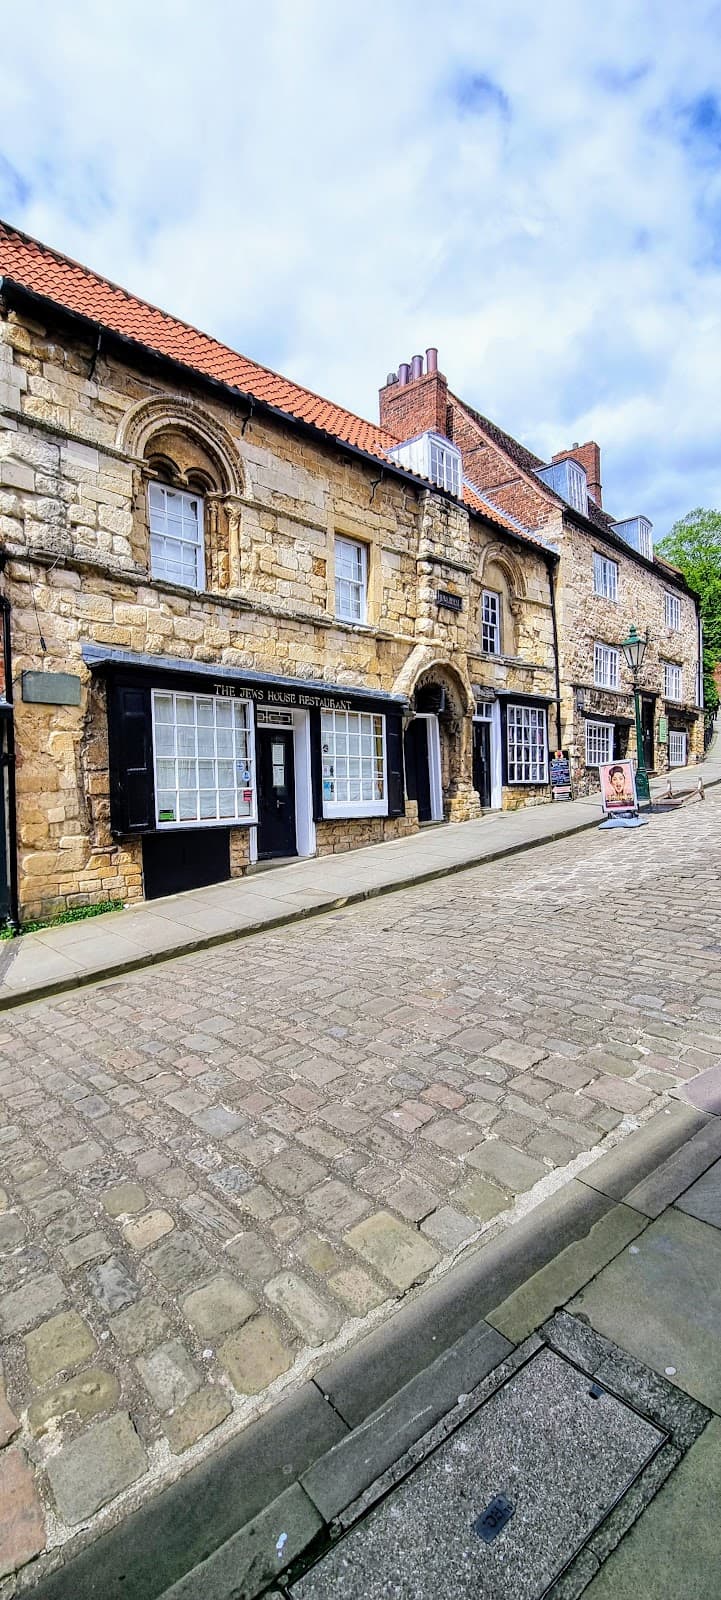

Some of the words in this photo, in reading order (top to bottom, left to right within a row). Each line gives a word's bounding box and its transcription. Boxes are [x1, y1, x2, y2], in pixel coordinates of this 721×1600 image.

[214, 684, 236, 697] THE
[240, 687, 264, 700] JEWS
[267, 690, 296, 704] HOUSE
[298, 694, 352, 710] RESTAURANT
